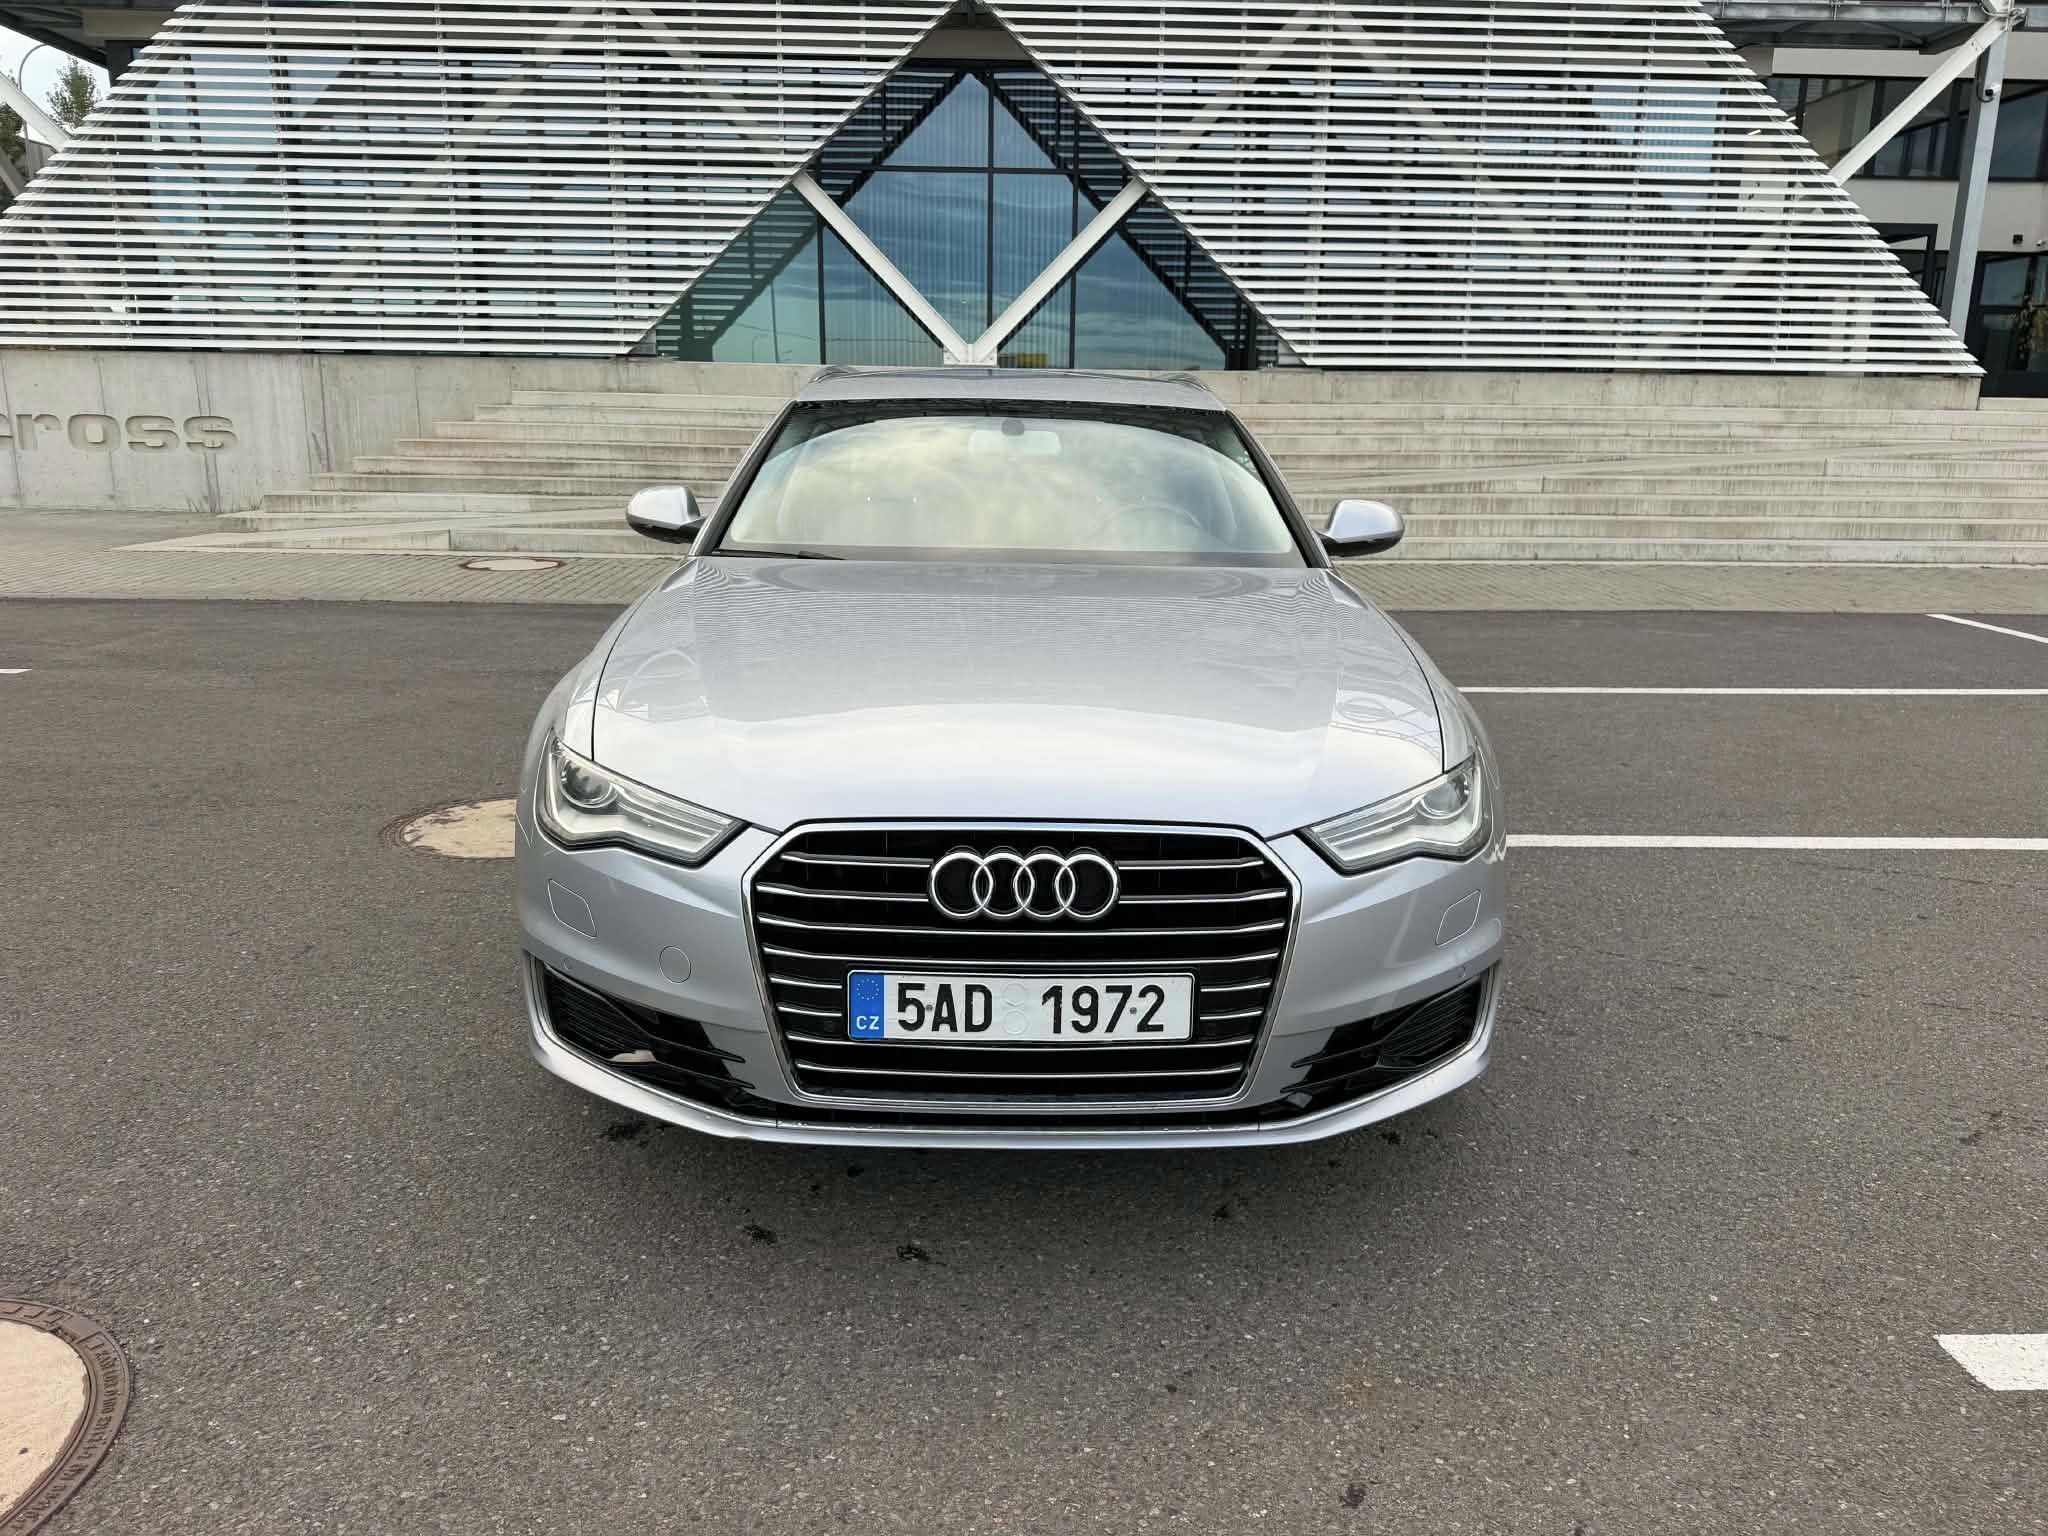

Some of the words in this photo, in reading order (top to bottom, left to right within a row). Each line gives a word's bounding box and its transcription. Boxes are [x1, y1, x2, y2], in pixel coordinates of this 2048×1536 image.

[0, 413, 240, 452] ross
[855, 1015, 880, 1031] CZ
[897, 982, 993, 1032] 5AD
[1041, 984, 1166, 1034] 1972
